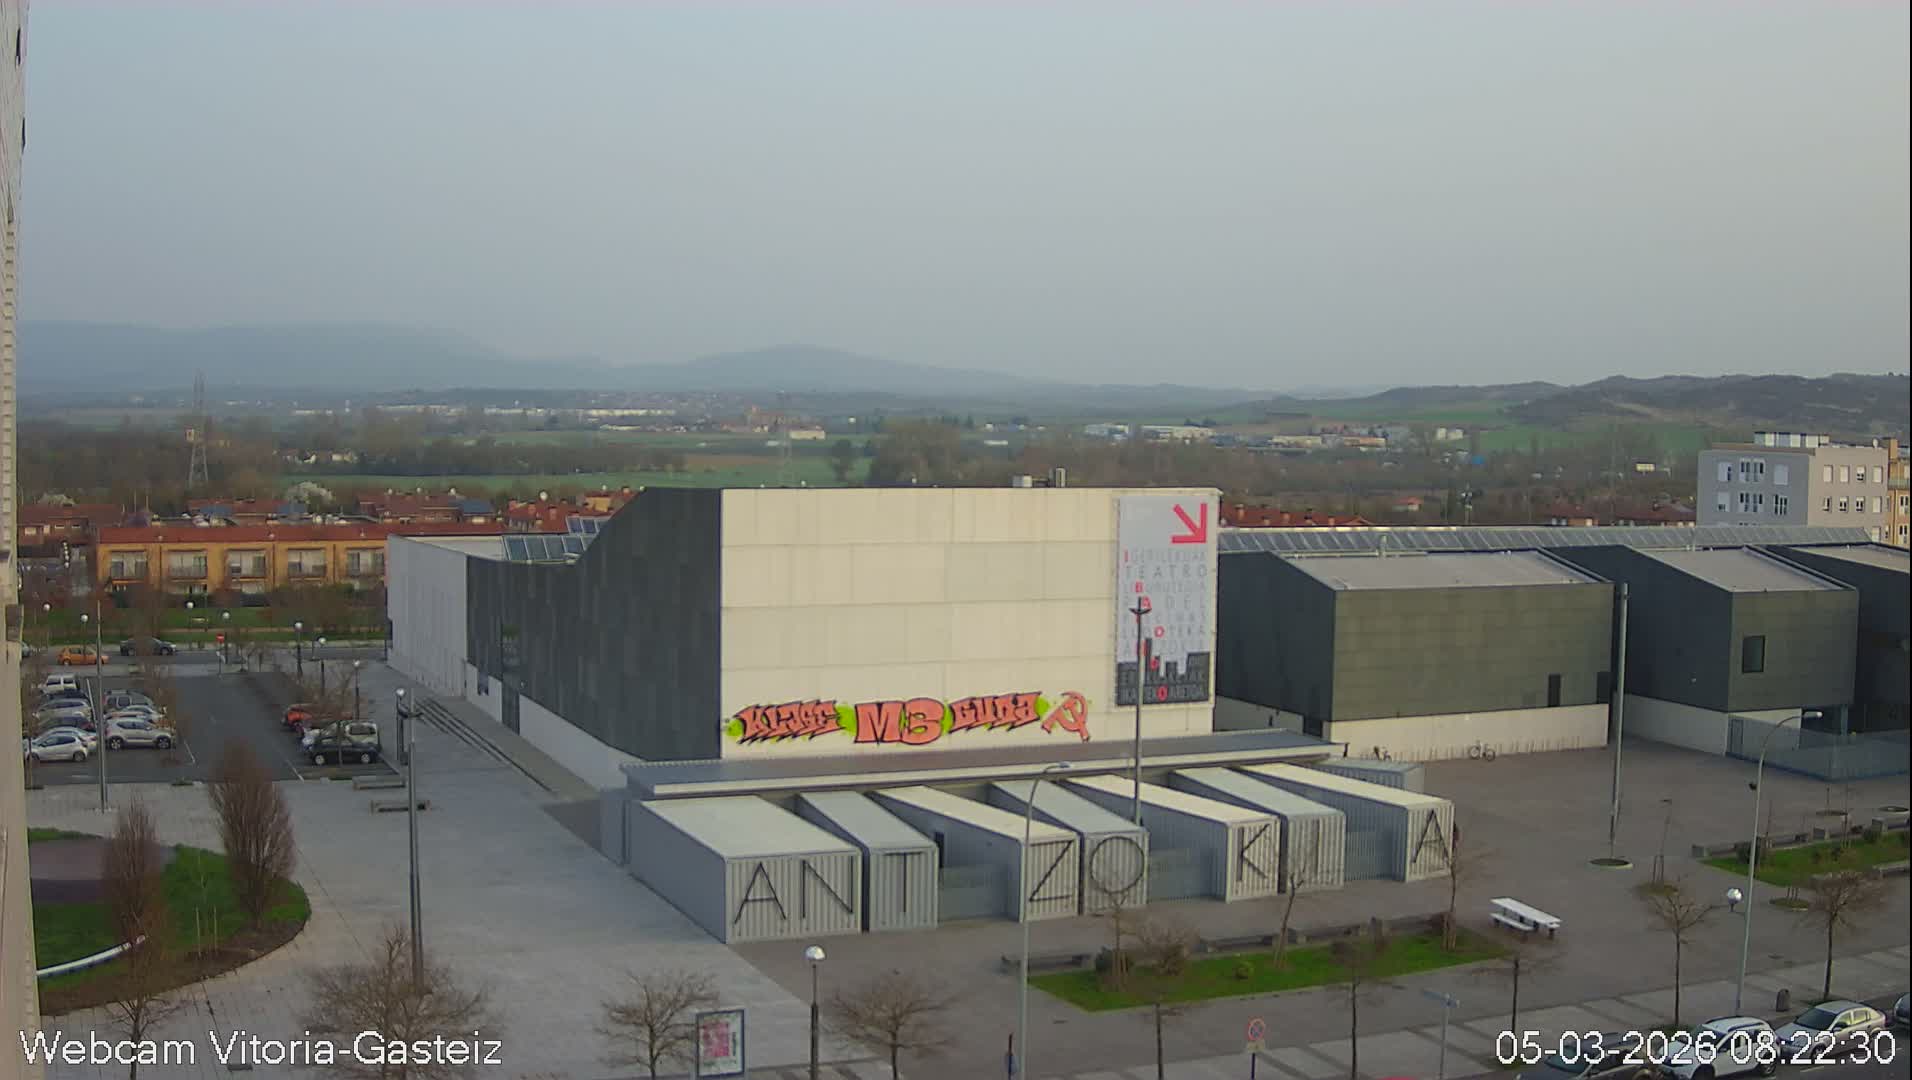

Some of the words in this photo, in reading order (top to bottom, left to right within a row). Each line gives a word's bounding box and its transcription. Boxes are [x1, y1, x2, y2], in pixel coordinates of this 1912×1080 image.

[1125, 565, 1208, 579] TEATRO
[853, 697, 945, 746] M3
[733, 808, 1452, 924] ANTZOKIA
